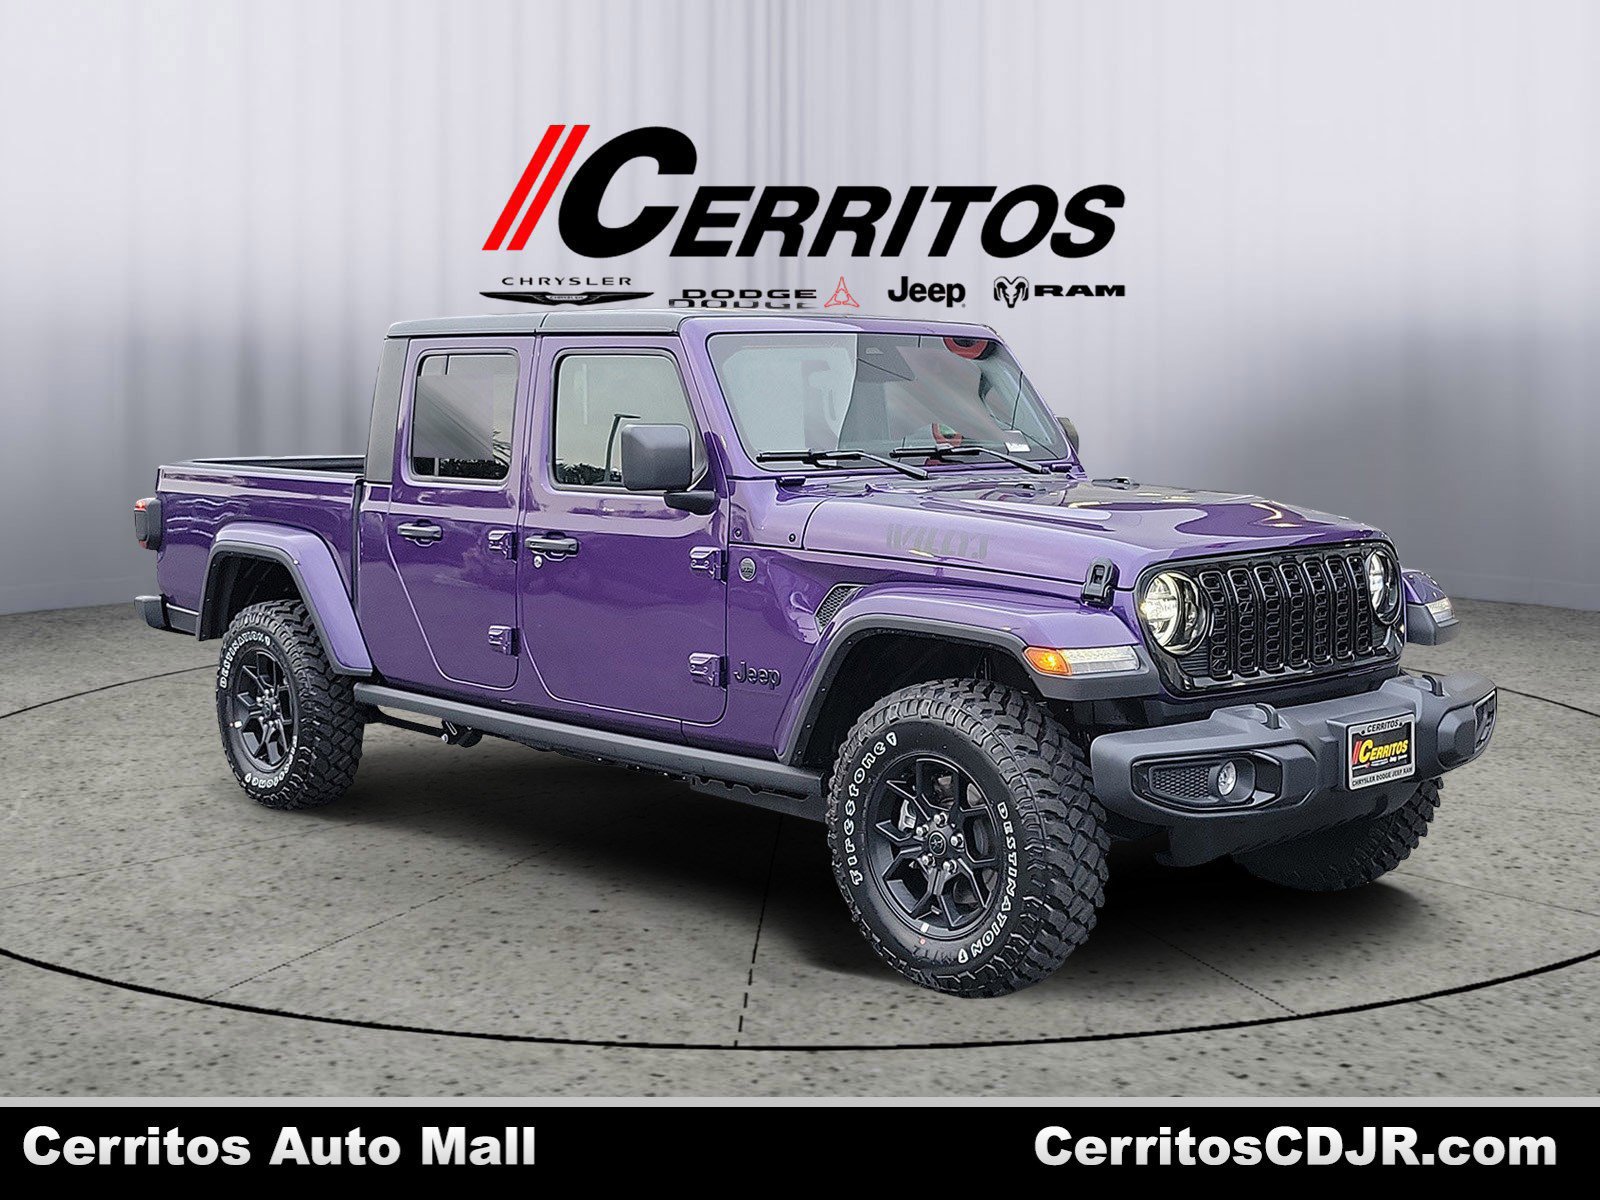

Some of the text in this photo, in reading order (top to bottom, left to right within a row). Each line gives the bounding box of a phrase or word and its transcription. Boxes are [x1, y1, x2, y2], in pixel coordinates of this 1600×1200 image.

[733, 661, 781, 690] Jeep
[1366, 719, 1399, 733] CERRITOS
[1352, 776, 1376, 787] CHRYSLER
[1376, 771, 1391, 782] DODGE
[1403, 766, 1413, 775] RAM
[970, 801, 1018, 958] DESTINATION
